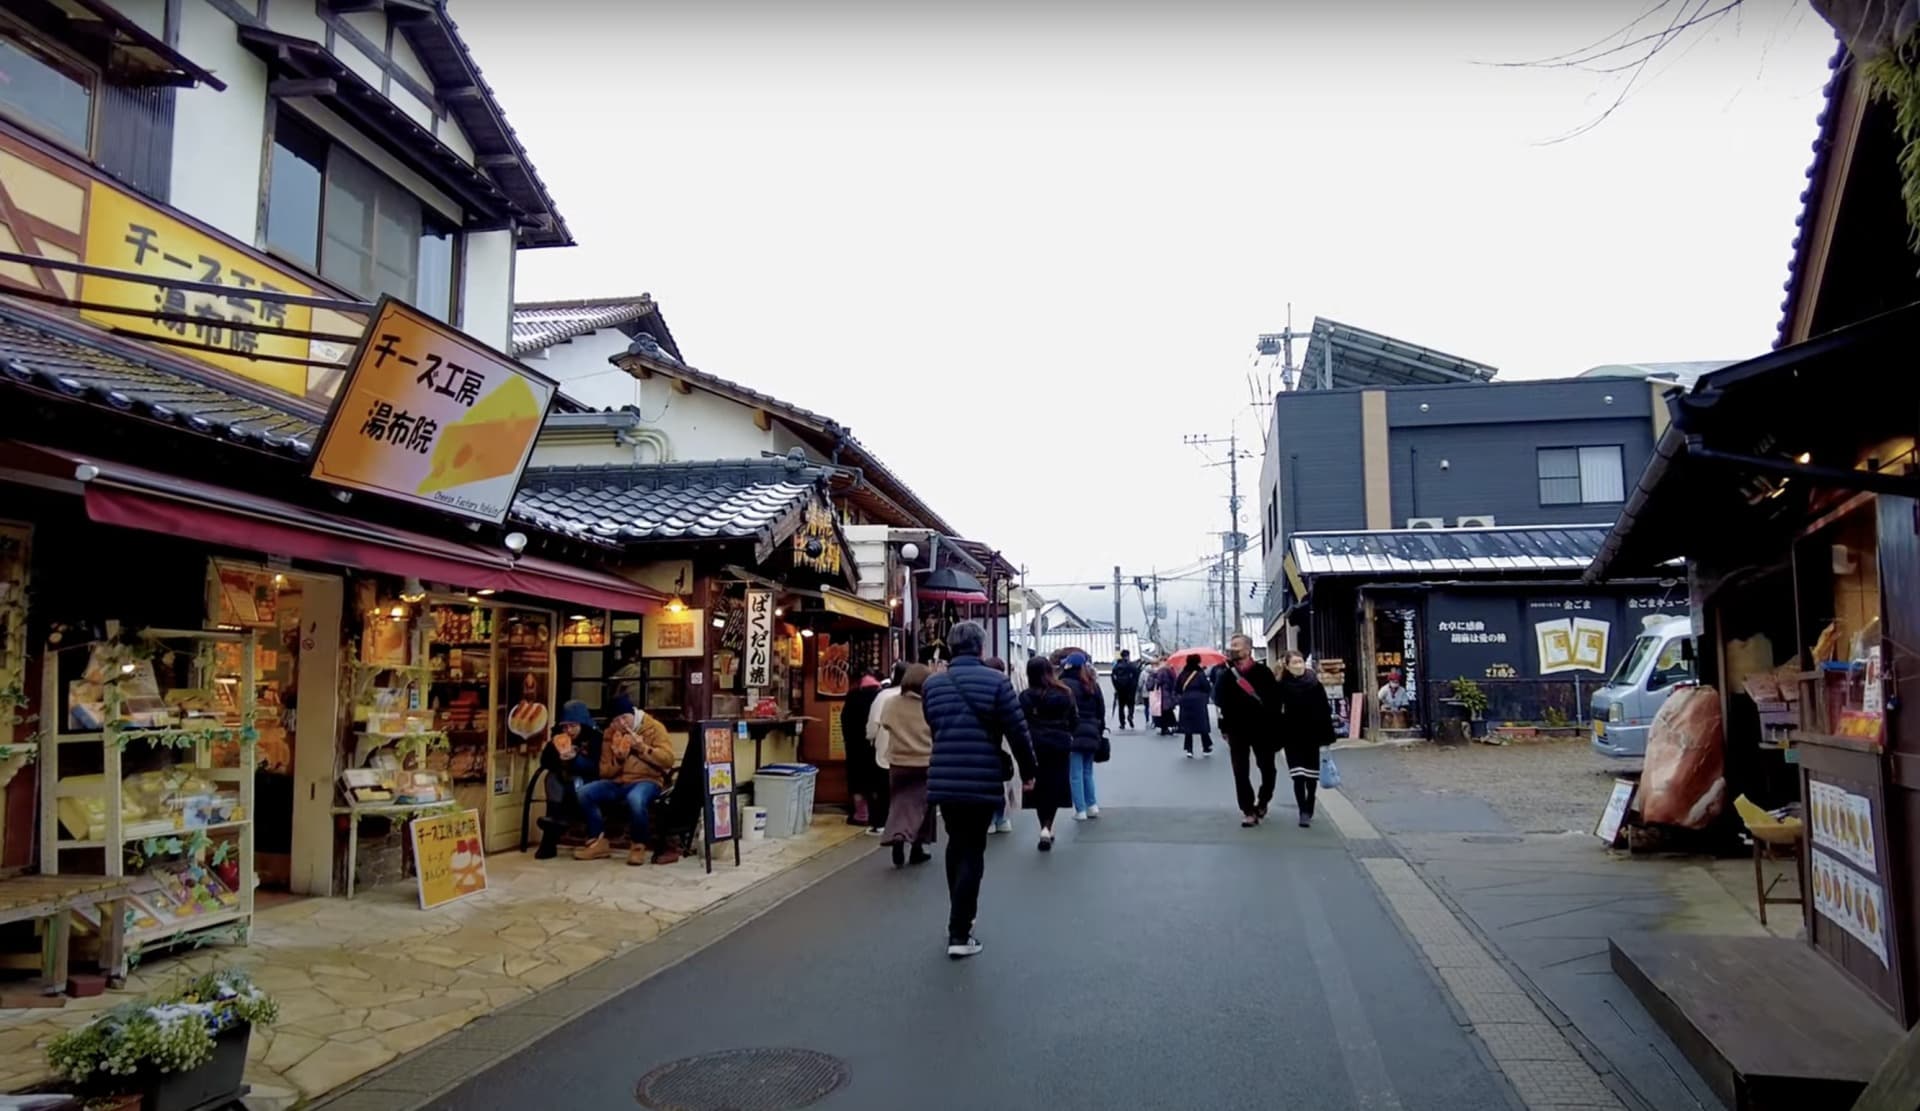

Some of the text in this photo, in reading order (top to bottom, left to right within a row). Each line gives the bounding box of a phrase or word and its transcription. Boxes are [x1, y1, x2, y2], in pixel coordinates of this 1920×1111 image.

[125, 222, 287, 329] チーズ工房
[374, 334, 484, 407] チーズ工房
[360, 400, 437, 454] 湯布院
[456, 496, 478, 509] Factory
[1563, 599, 1592, 610] 金ごま
[750, 593, 770, 684] ばくだん焼
[1403, 608, 1416, 659] ごま専門店
